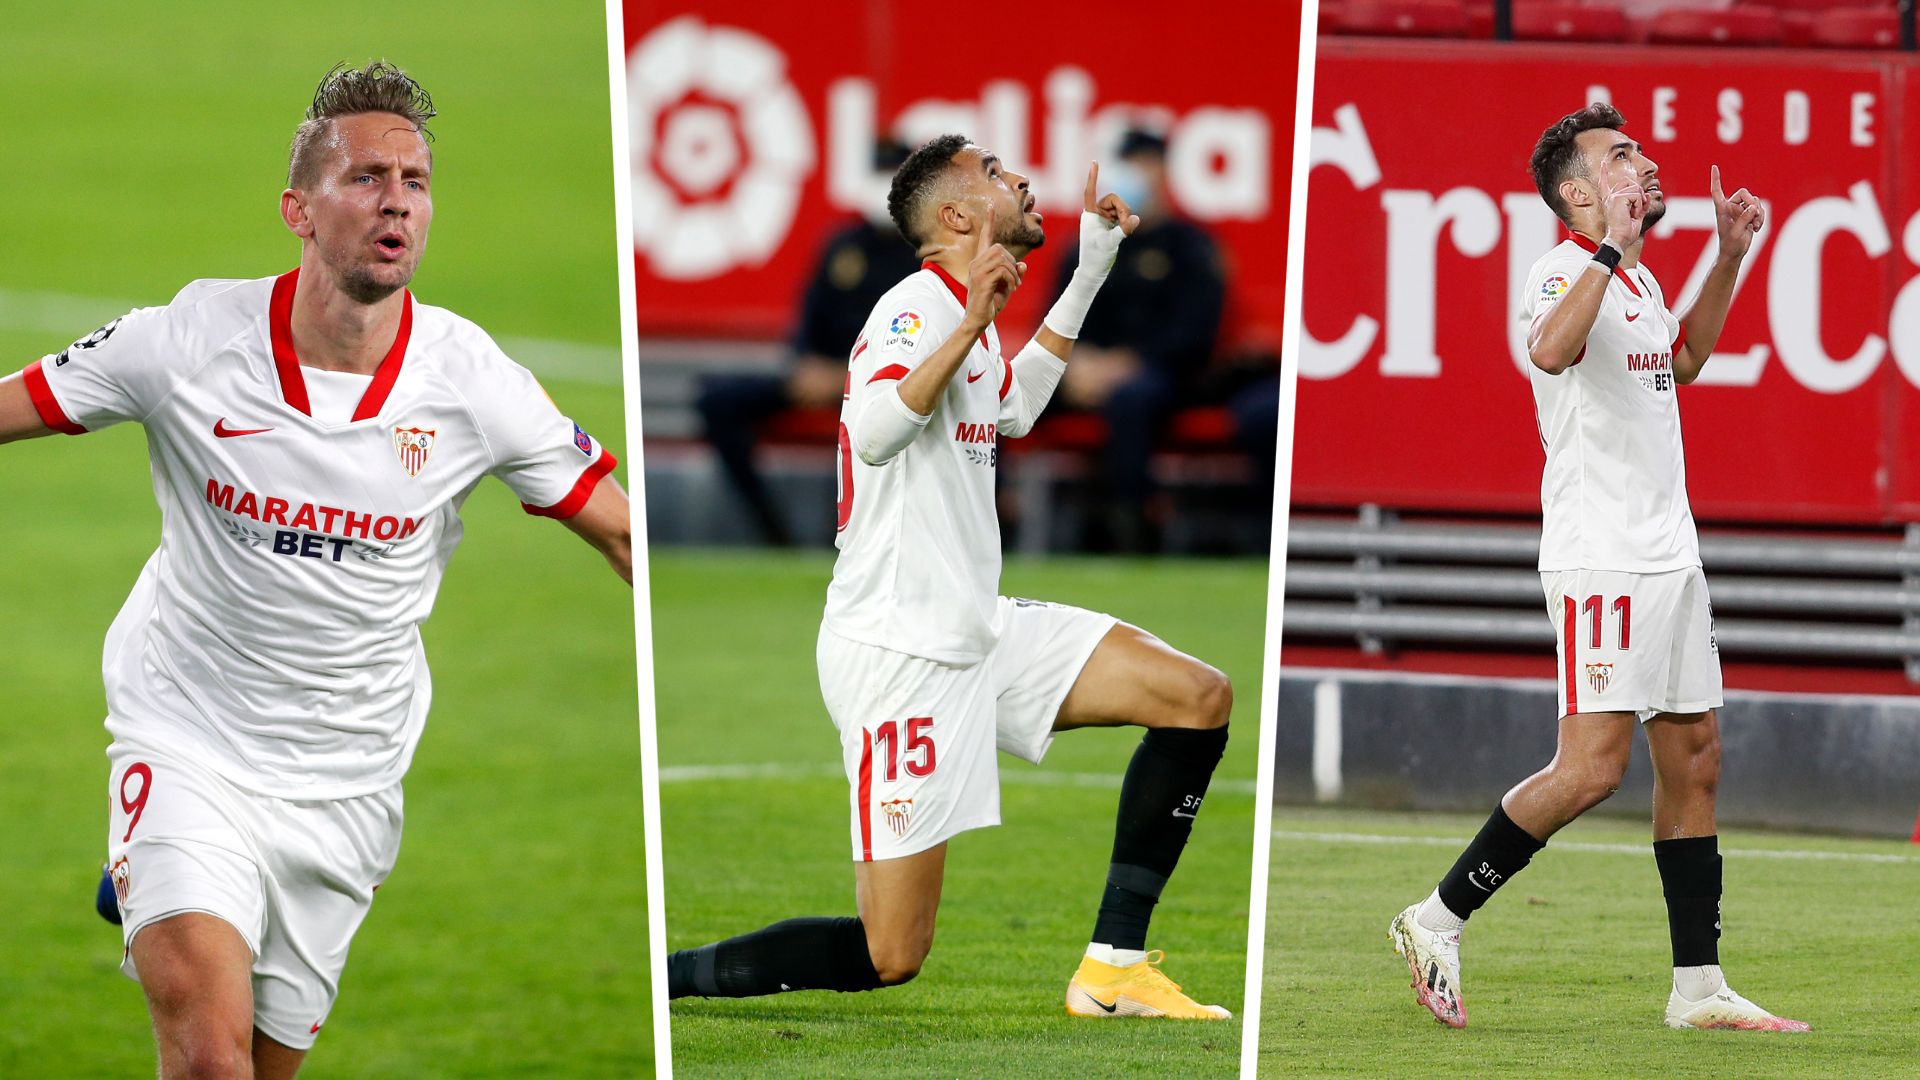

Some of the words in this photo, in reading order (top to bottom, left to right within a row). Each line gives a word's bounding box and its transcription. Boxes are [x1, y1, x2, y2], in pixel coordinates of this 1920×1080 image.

[1627, 352, 1672, 371] MARAT
[206, 478, 425, 541] MARATHON
[272, 530, 353, 562] BET
[1582, 594, 1631, 651] 11
[875, 716, 937, 782] 15
[120, 761, 153, 843] 9
[1182, 794, 1204, 810] SF
[1478, 861, 1502, 885] SFC
